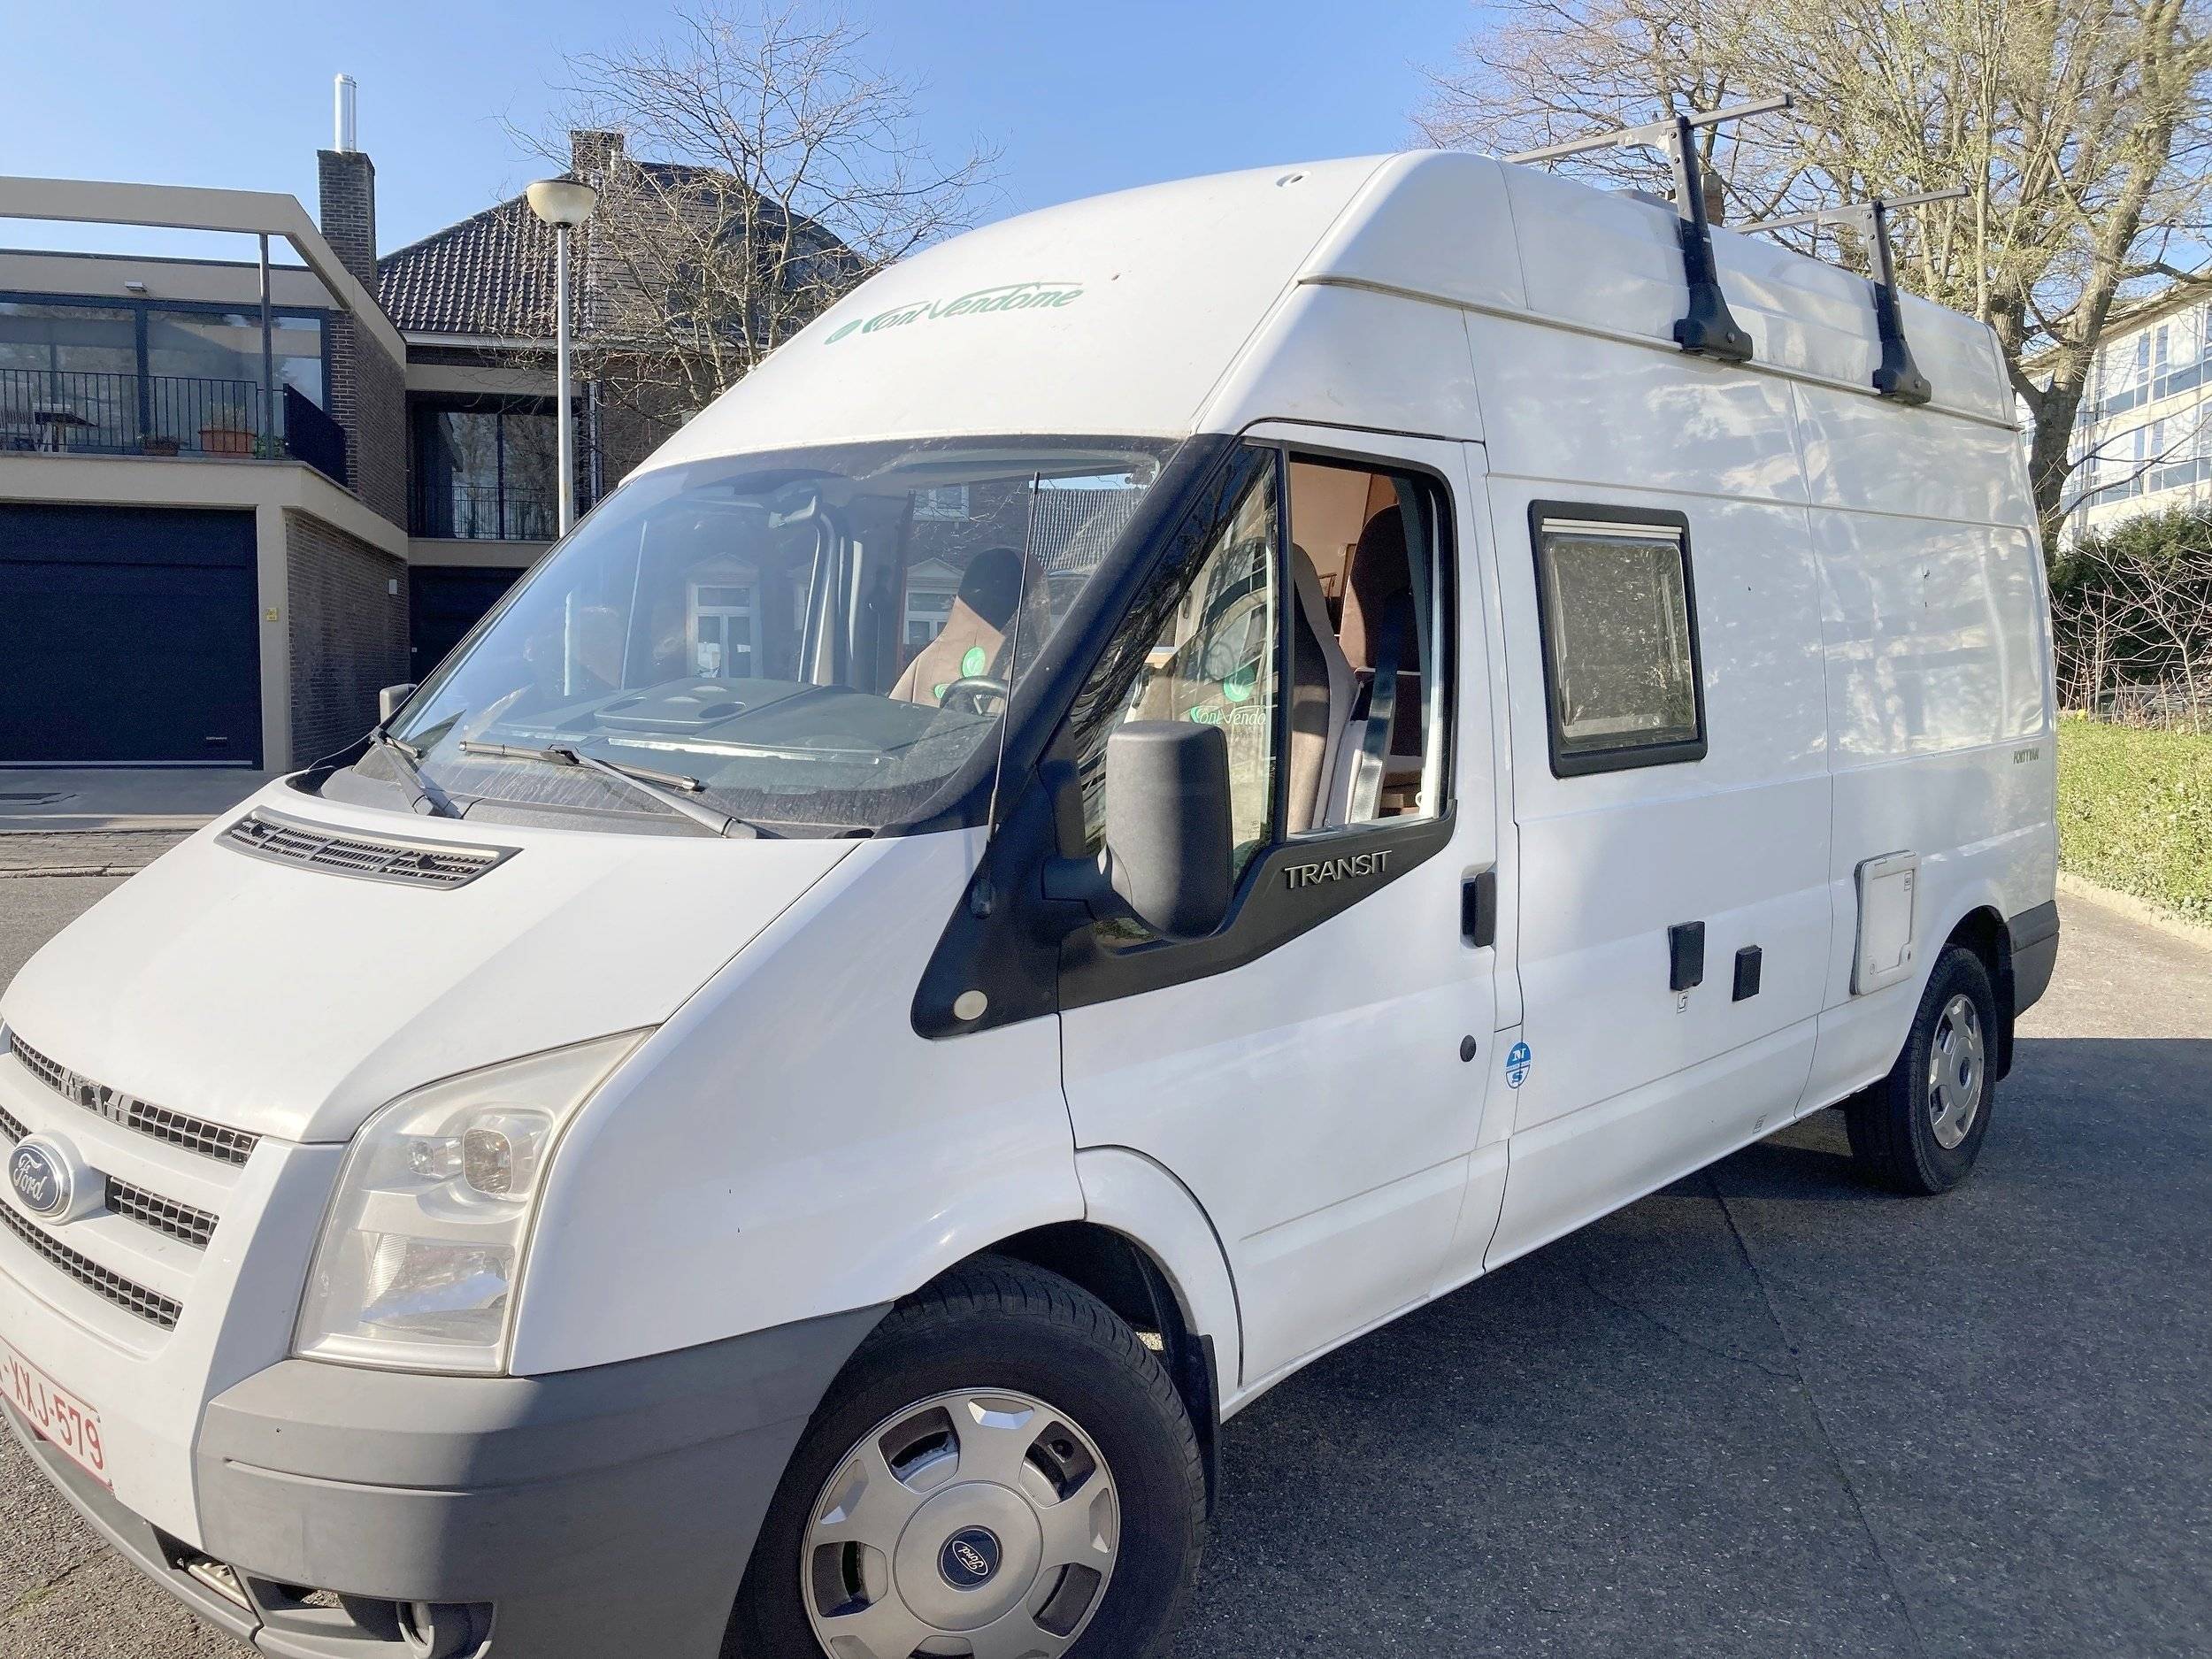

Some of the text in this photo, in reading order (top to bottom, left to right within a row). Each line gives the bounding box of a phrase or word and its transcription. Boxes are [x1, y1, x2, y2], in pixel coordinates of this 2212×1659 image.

[1284, 849, 1393, 889] TRANSIT
[12, 1152, 48, 1202] Ford
[956, 1545, 985, 1571] Ford
